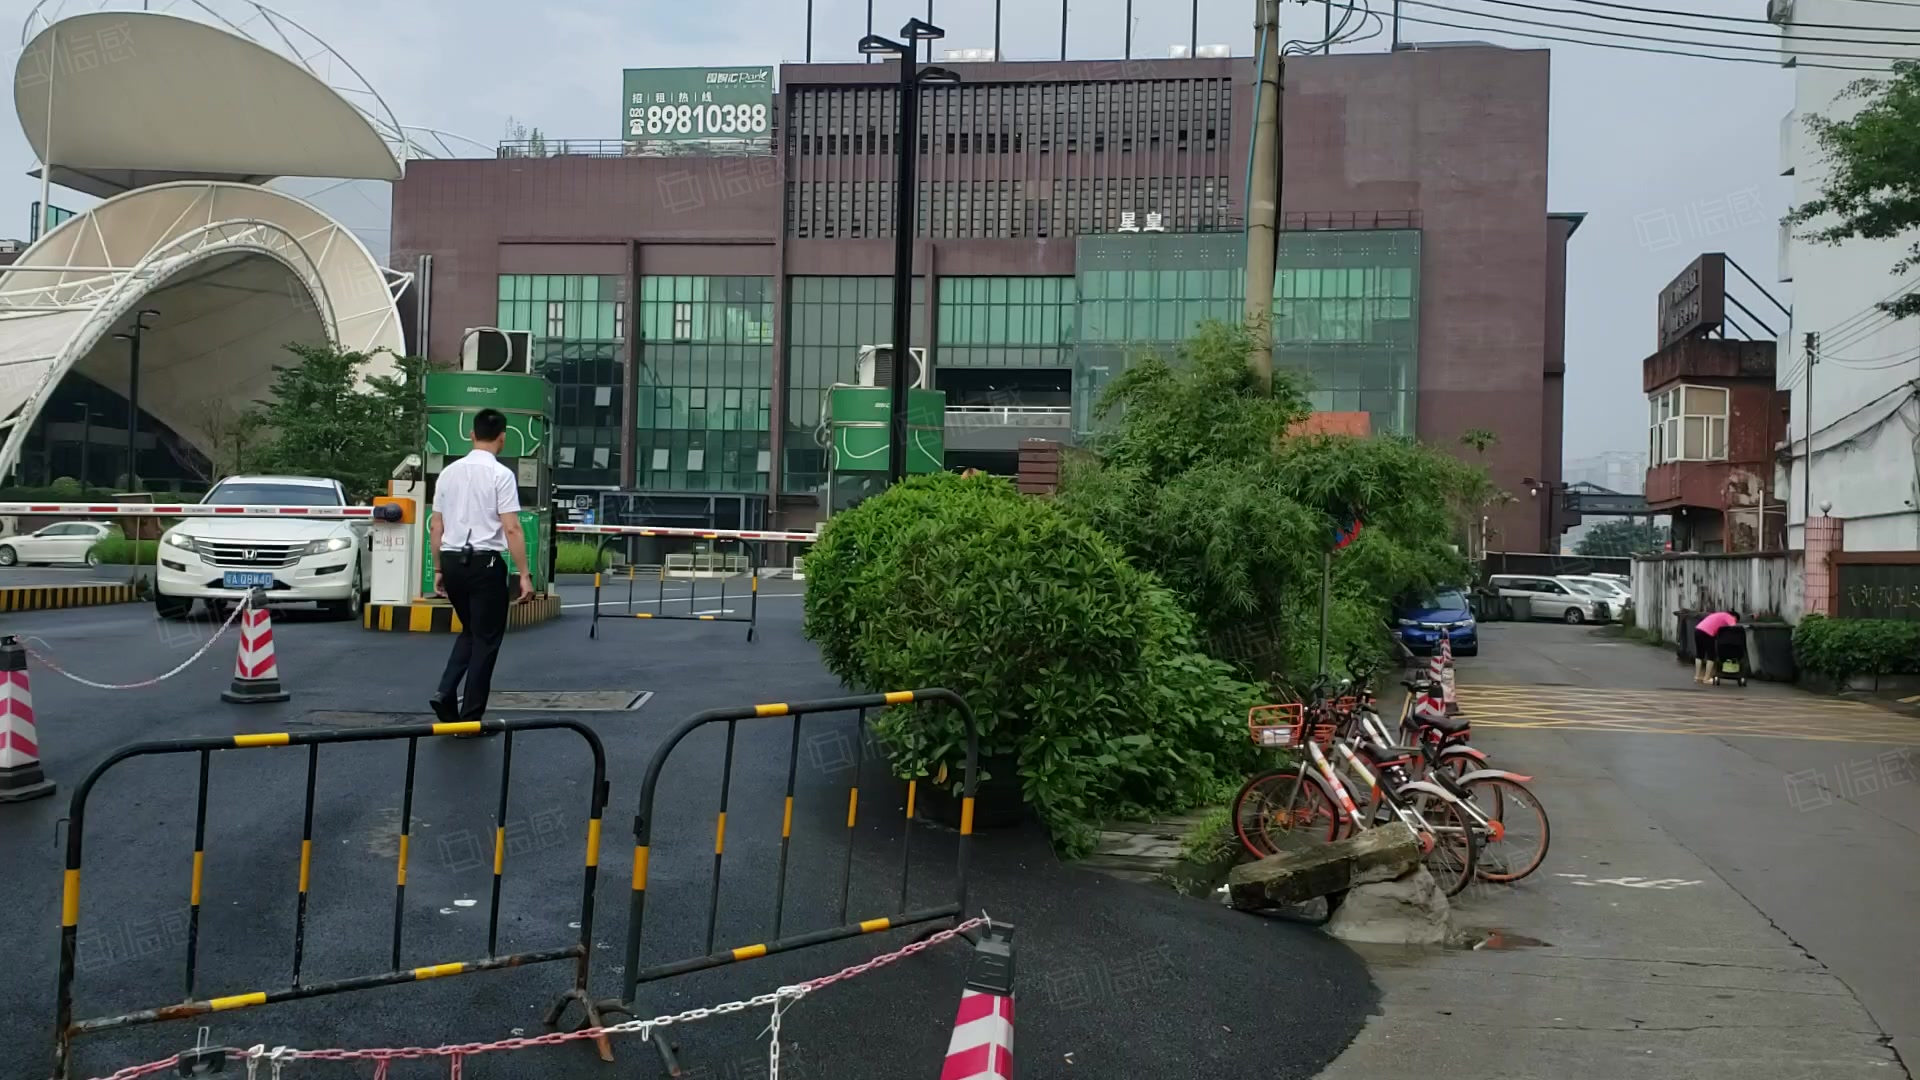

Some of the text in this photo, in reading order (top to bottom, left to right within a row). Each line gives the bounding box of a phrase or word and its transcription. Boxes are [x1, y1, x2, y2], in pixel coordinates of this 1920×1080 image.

[739, 69, 768, 84] Park
[629, 108, 644, 118] 020
[647, 103, 766, 134] 89810388
[383, 536, 404, 547] 出口
